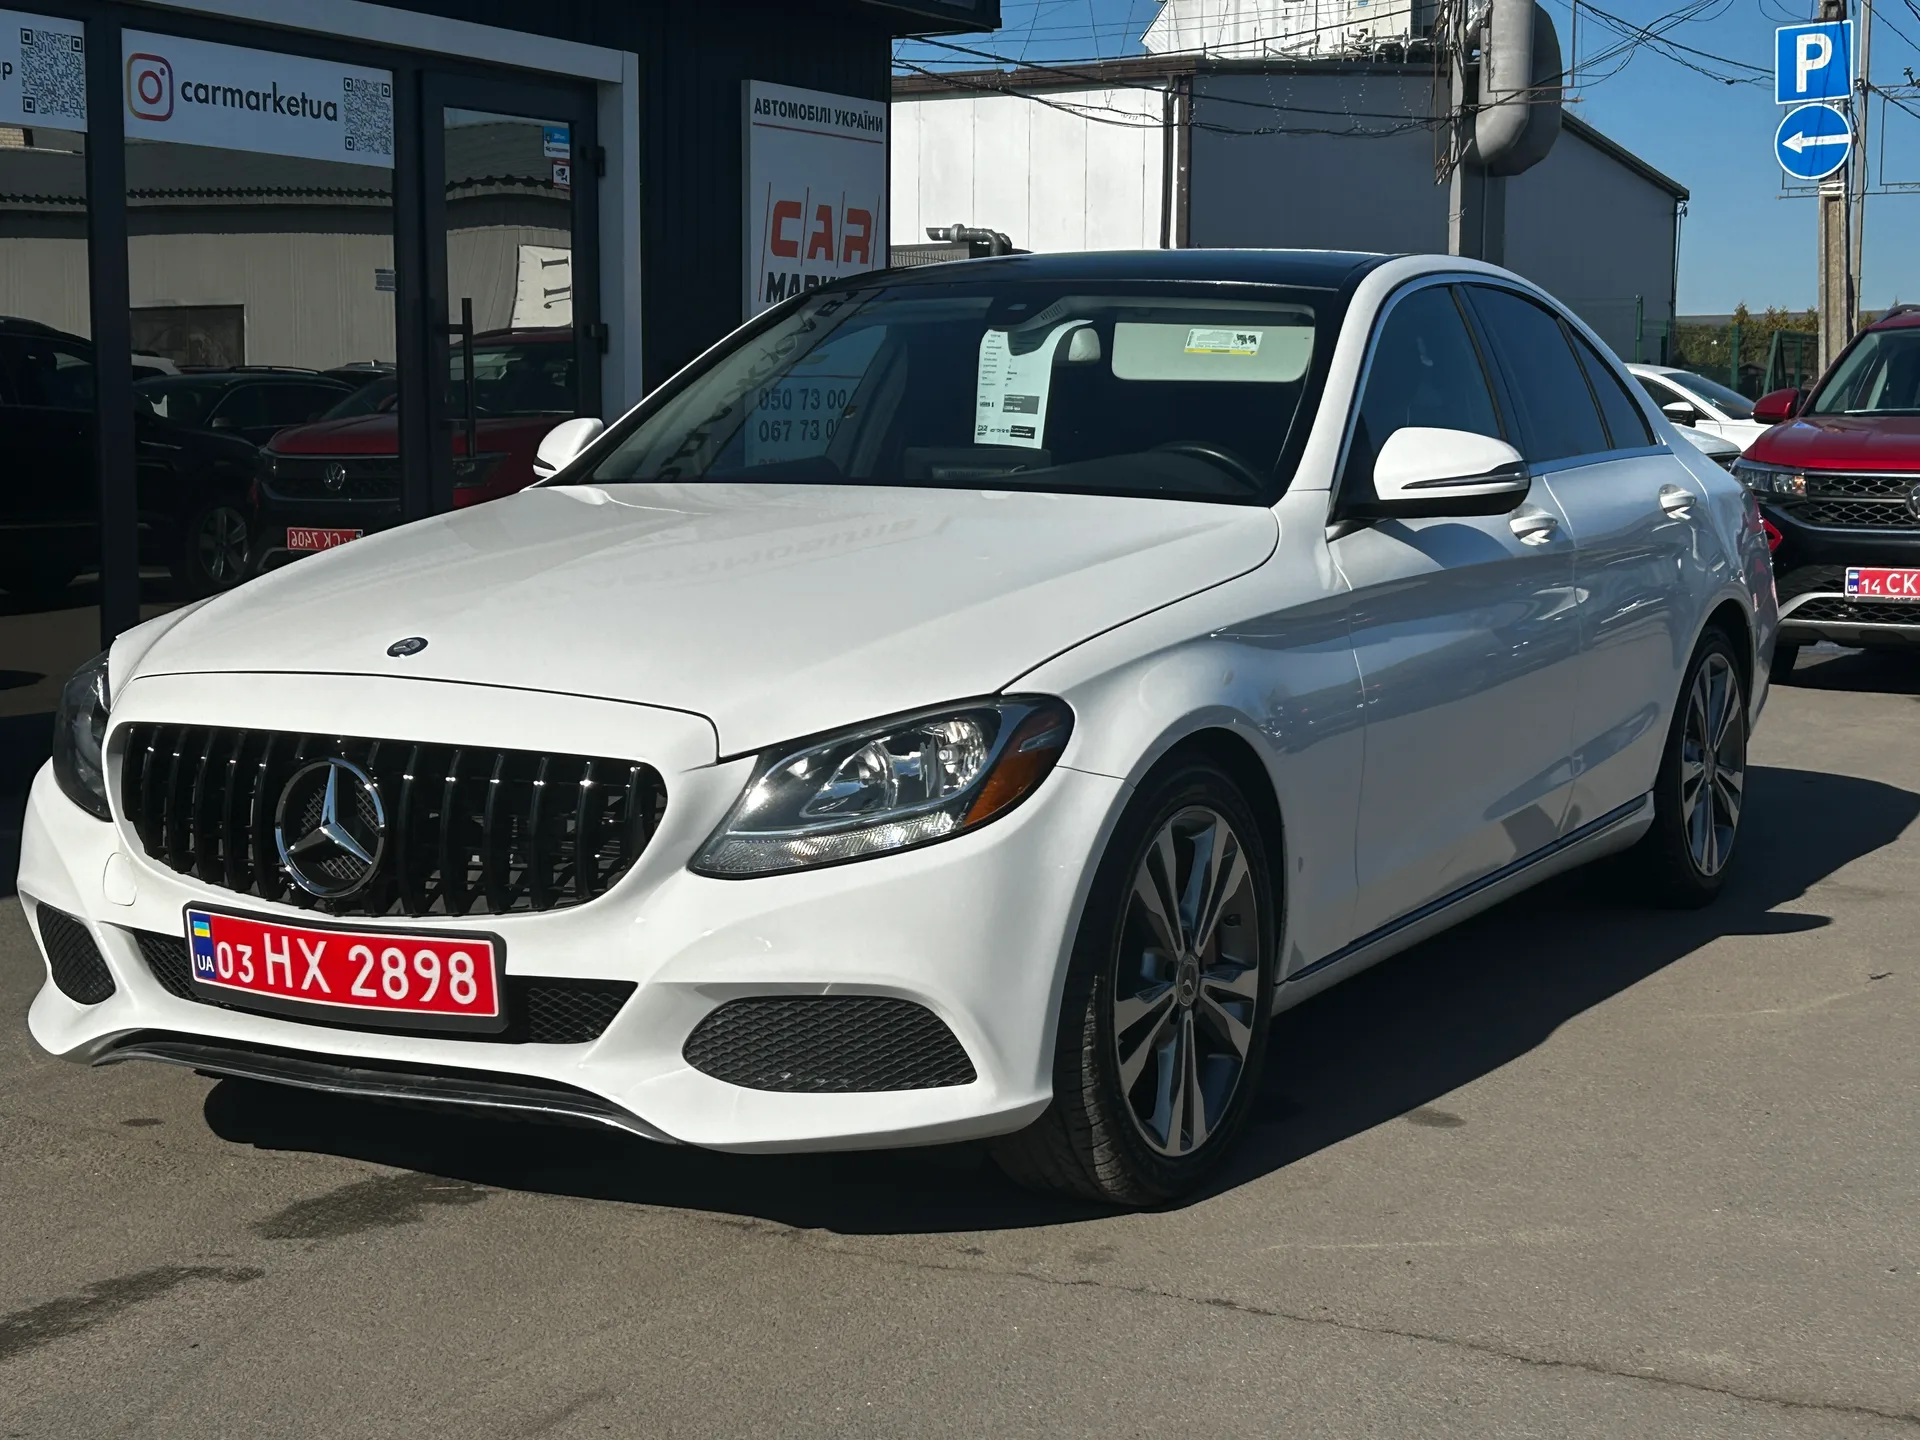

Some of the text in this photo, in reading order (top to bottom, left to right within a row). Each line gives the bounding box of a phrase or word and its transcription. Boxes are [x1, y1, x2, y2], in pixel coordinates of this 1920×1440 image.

[1796, 33, 1833, 93] P
[181, 82, 338, 122] carmarketua
[754, 98, 883, 132] АВТОМОБІЛІ УКРАЇНИ
[770, 200, 872, 265] CAR
[759, 388, 846, 410] 050 73 00
[759, 420, 792, 442] 067
[800, 419, 819, 441] 73
[1861, 573, 1918, 594] 14 CK
[197, 954, 214, 973] UA
[216, 932, 477, 1005] 03 HX 2898
